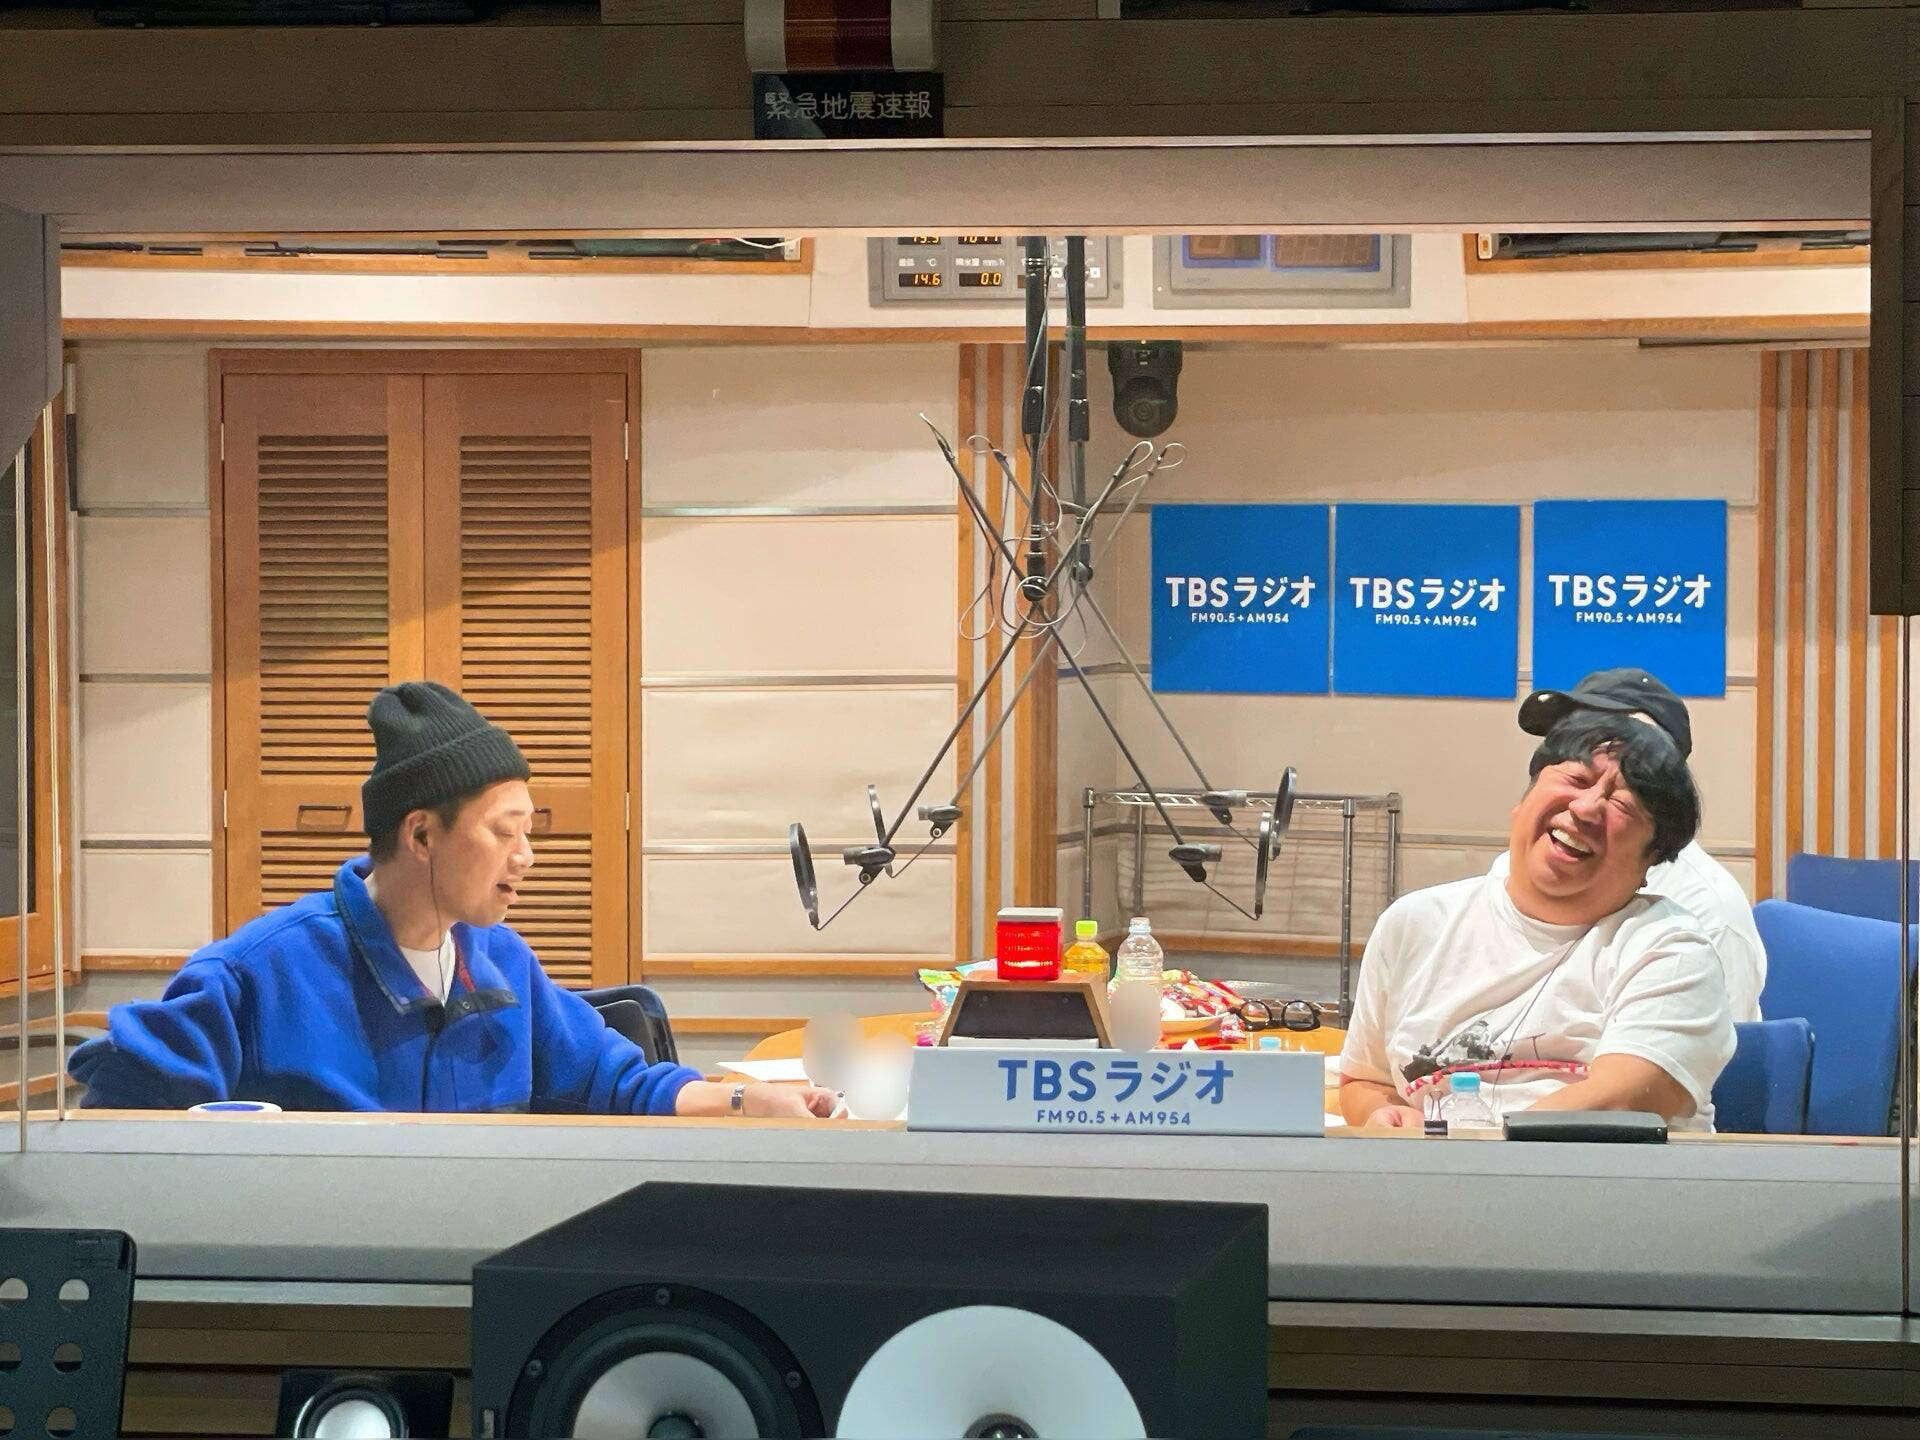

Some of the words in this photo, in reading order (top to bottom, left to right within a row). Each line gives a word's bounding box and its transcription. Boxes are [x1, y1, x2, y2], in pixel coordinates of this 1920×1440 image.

[764, 91, 933, 120] 緊急地震速報
[914, 273, 941, 286] 14.6
[980, 272, 1002, 286] 0.0
[1165, 576, 1316, 609] TBSラジオ
[1349, 578, 1506, 612] TBSラジオ
[1548, 574, 1712, 609] TBSラジオ
[998, 1059, 1234, 1105] TBSラジオ
